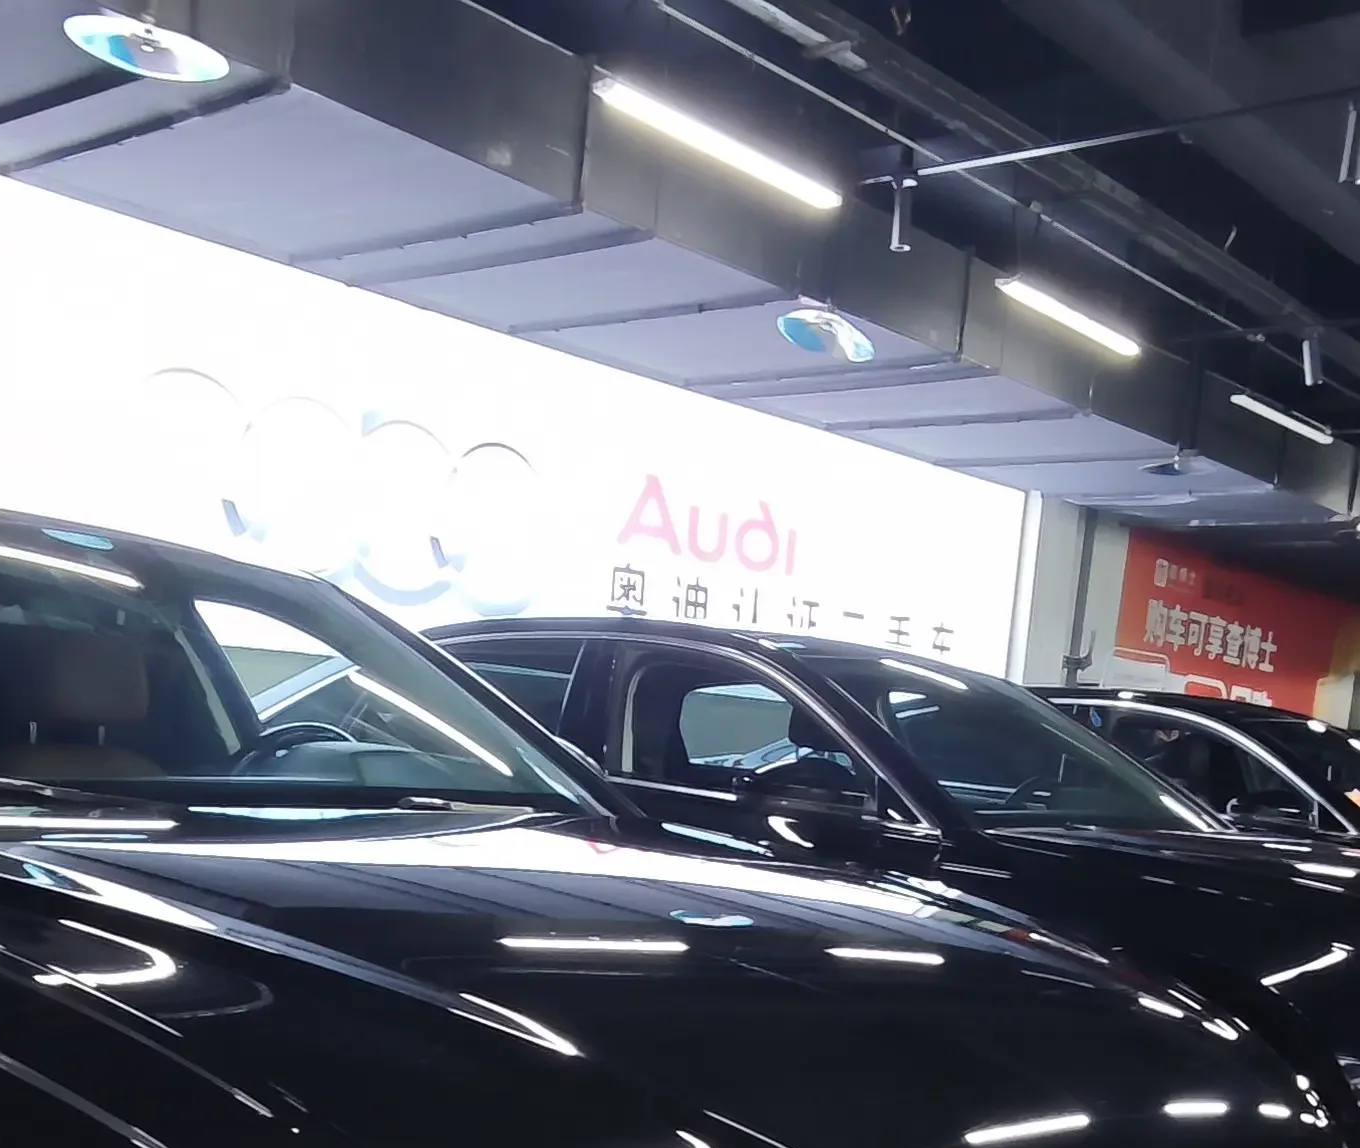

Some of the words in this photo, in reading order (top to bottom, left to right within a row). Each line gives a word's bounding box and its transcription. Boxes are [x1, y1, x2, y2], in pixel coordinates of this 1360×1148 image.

[617, 473, 797, 576] Audi
[1143, 599, 1278, 673] 购车可享查博士
